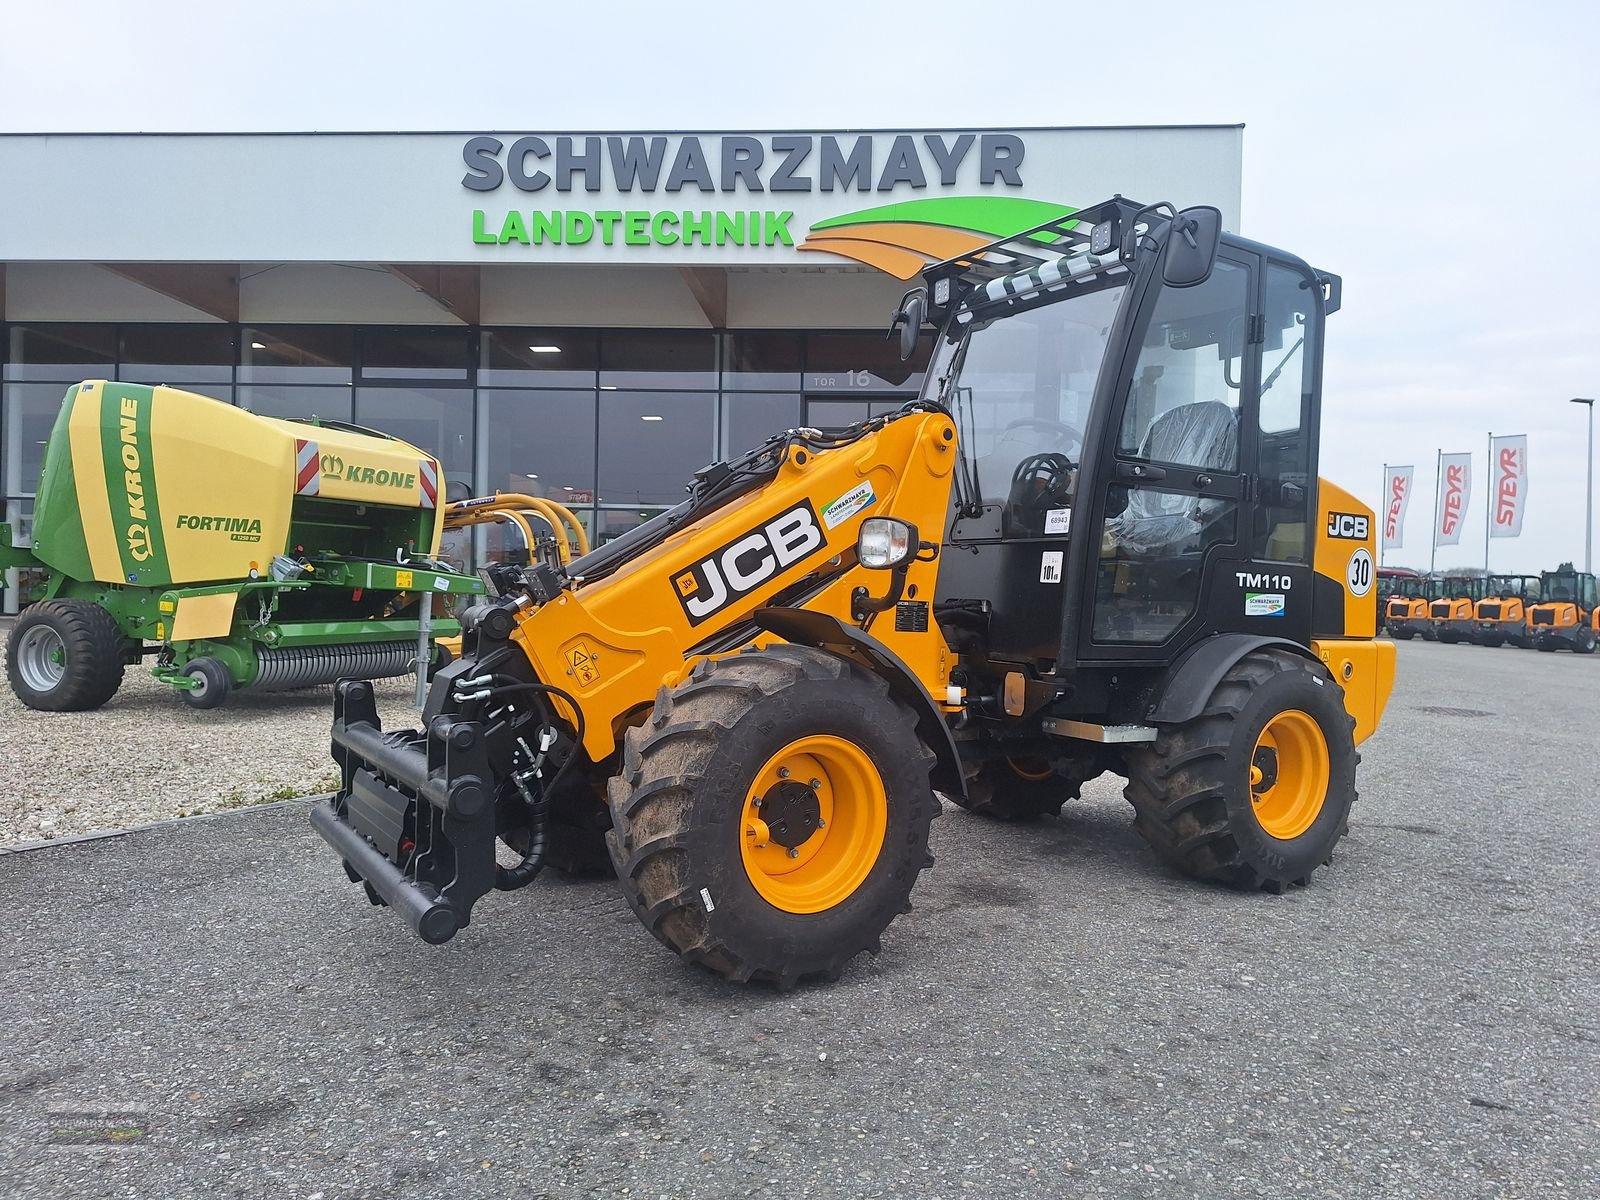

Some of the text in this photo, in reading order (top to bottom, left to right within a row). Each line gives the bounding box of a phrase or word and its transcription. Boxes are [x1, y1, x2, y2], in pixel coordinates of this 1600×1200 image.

[461, 134, 1026, 193] SCHWARZMAYR
[472, 209, 794, 246] LANDTECHNIK
[814, 369, 871, 387] TOR 16
[119, 397, 148, 521] KRONE
[345, 465, 416, 490] KRONE
[1496, 447, 1518, 527] STEYR
[827, 489, 866, 516] SCHWARZMAYR
[1386, 475, 1406, 540] STEYR
[1442, 464, 1462, 537] STEYR
[176, 514, 262, 534] FORTIMA
[1050, 516, 1068, 524] 68943
[1328, 514, 1368, 538] JCB
[686, 507, 821, 618] JCB
[1043, 565, 1055, 580] 101
[1351, 557, 1369, 587] 30
[1235, 572, 1292, 590] TM110
